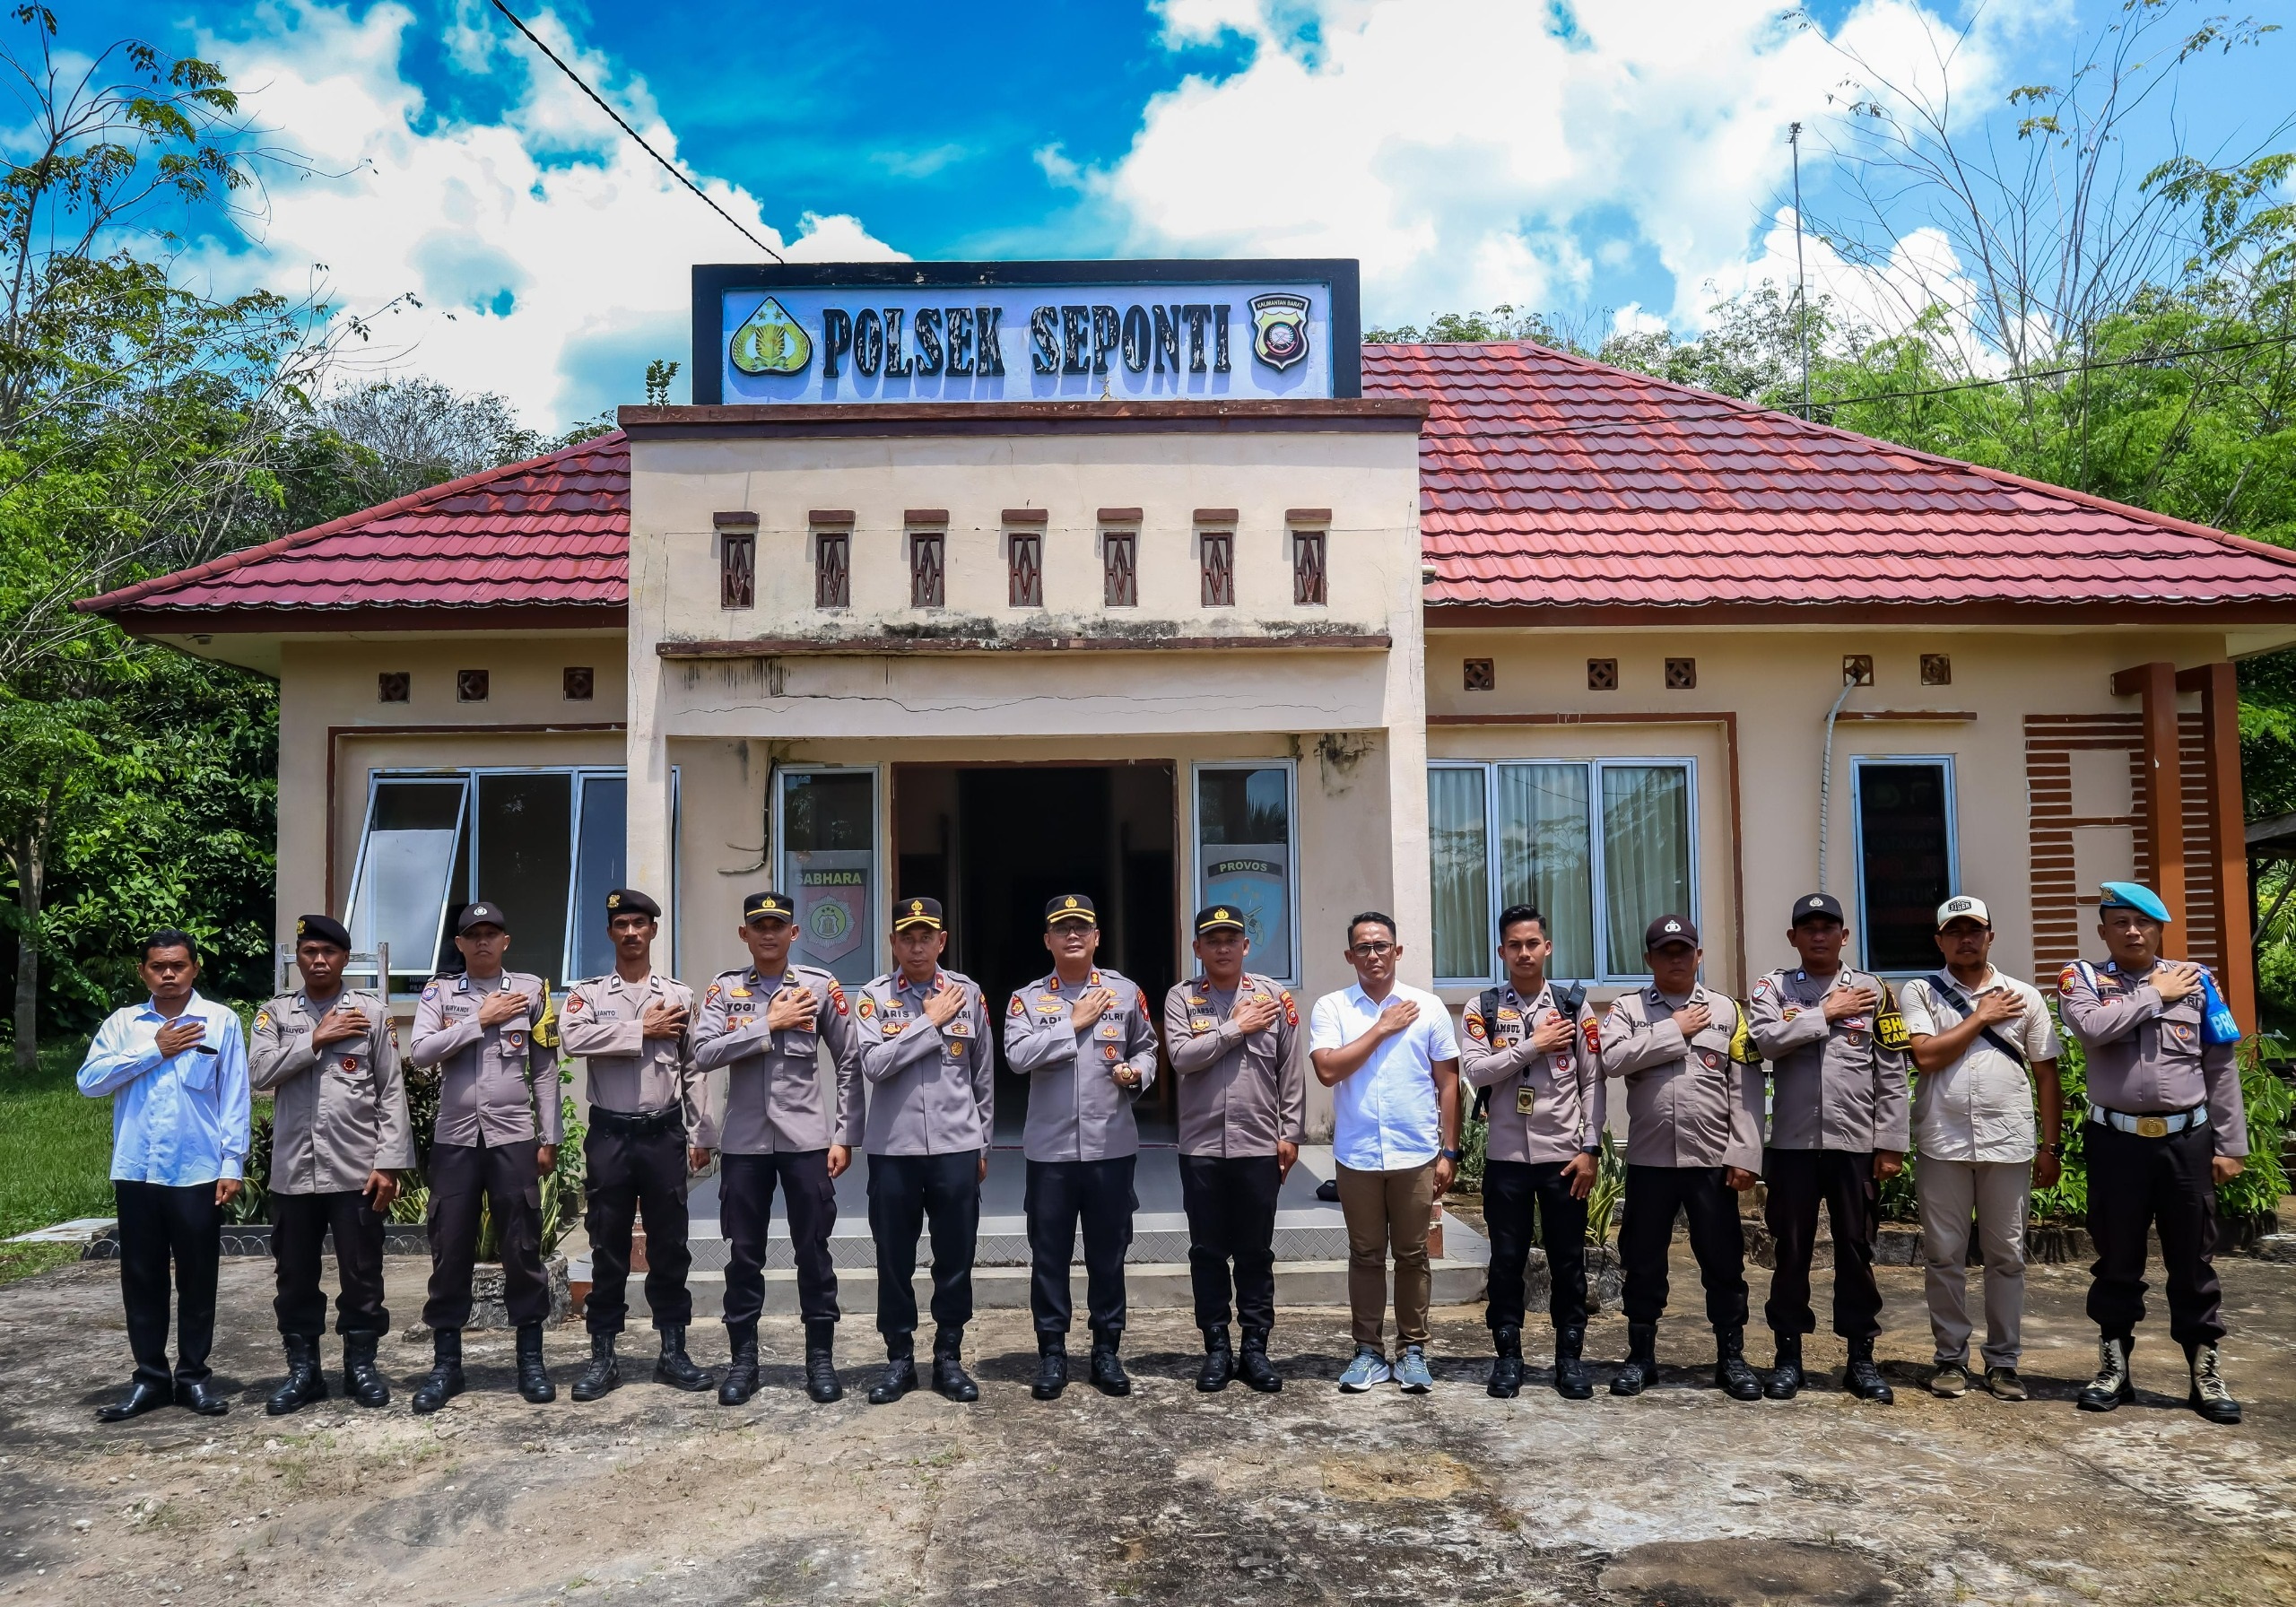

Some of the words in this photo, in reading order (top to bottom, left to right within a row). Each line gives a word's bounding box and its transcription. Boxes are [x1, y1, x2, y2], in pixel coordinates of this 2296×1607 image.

[1257, 300, 1286, 308] KALIMANTAN
[1287, 300, 1303, 308] BARAT
[822, 307, 1005, 378] POLSEK
[1031, 304, 1232, 374] SEPONTI
[1219, 861, 1268, 873] PROVOS
[795, 872, 862, 885] SABHARA
[1950, 901, 1970, 911] EIGER
[727, 1003, 756, 1012] YOGI
[1187, 1007, 1215, 1016] UDARSO
[883, 1009, 909, 1019] ARIS
[1100, 1012, 1124, 1021] OLRI
[1039, 1016, 1061, 1025] ADI
[1495, 1023, 1521, 1034] AMSUL
[1707, 1023, 1727, 1032] OLRI
